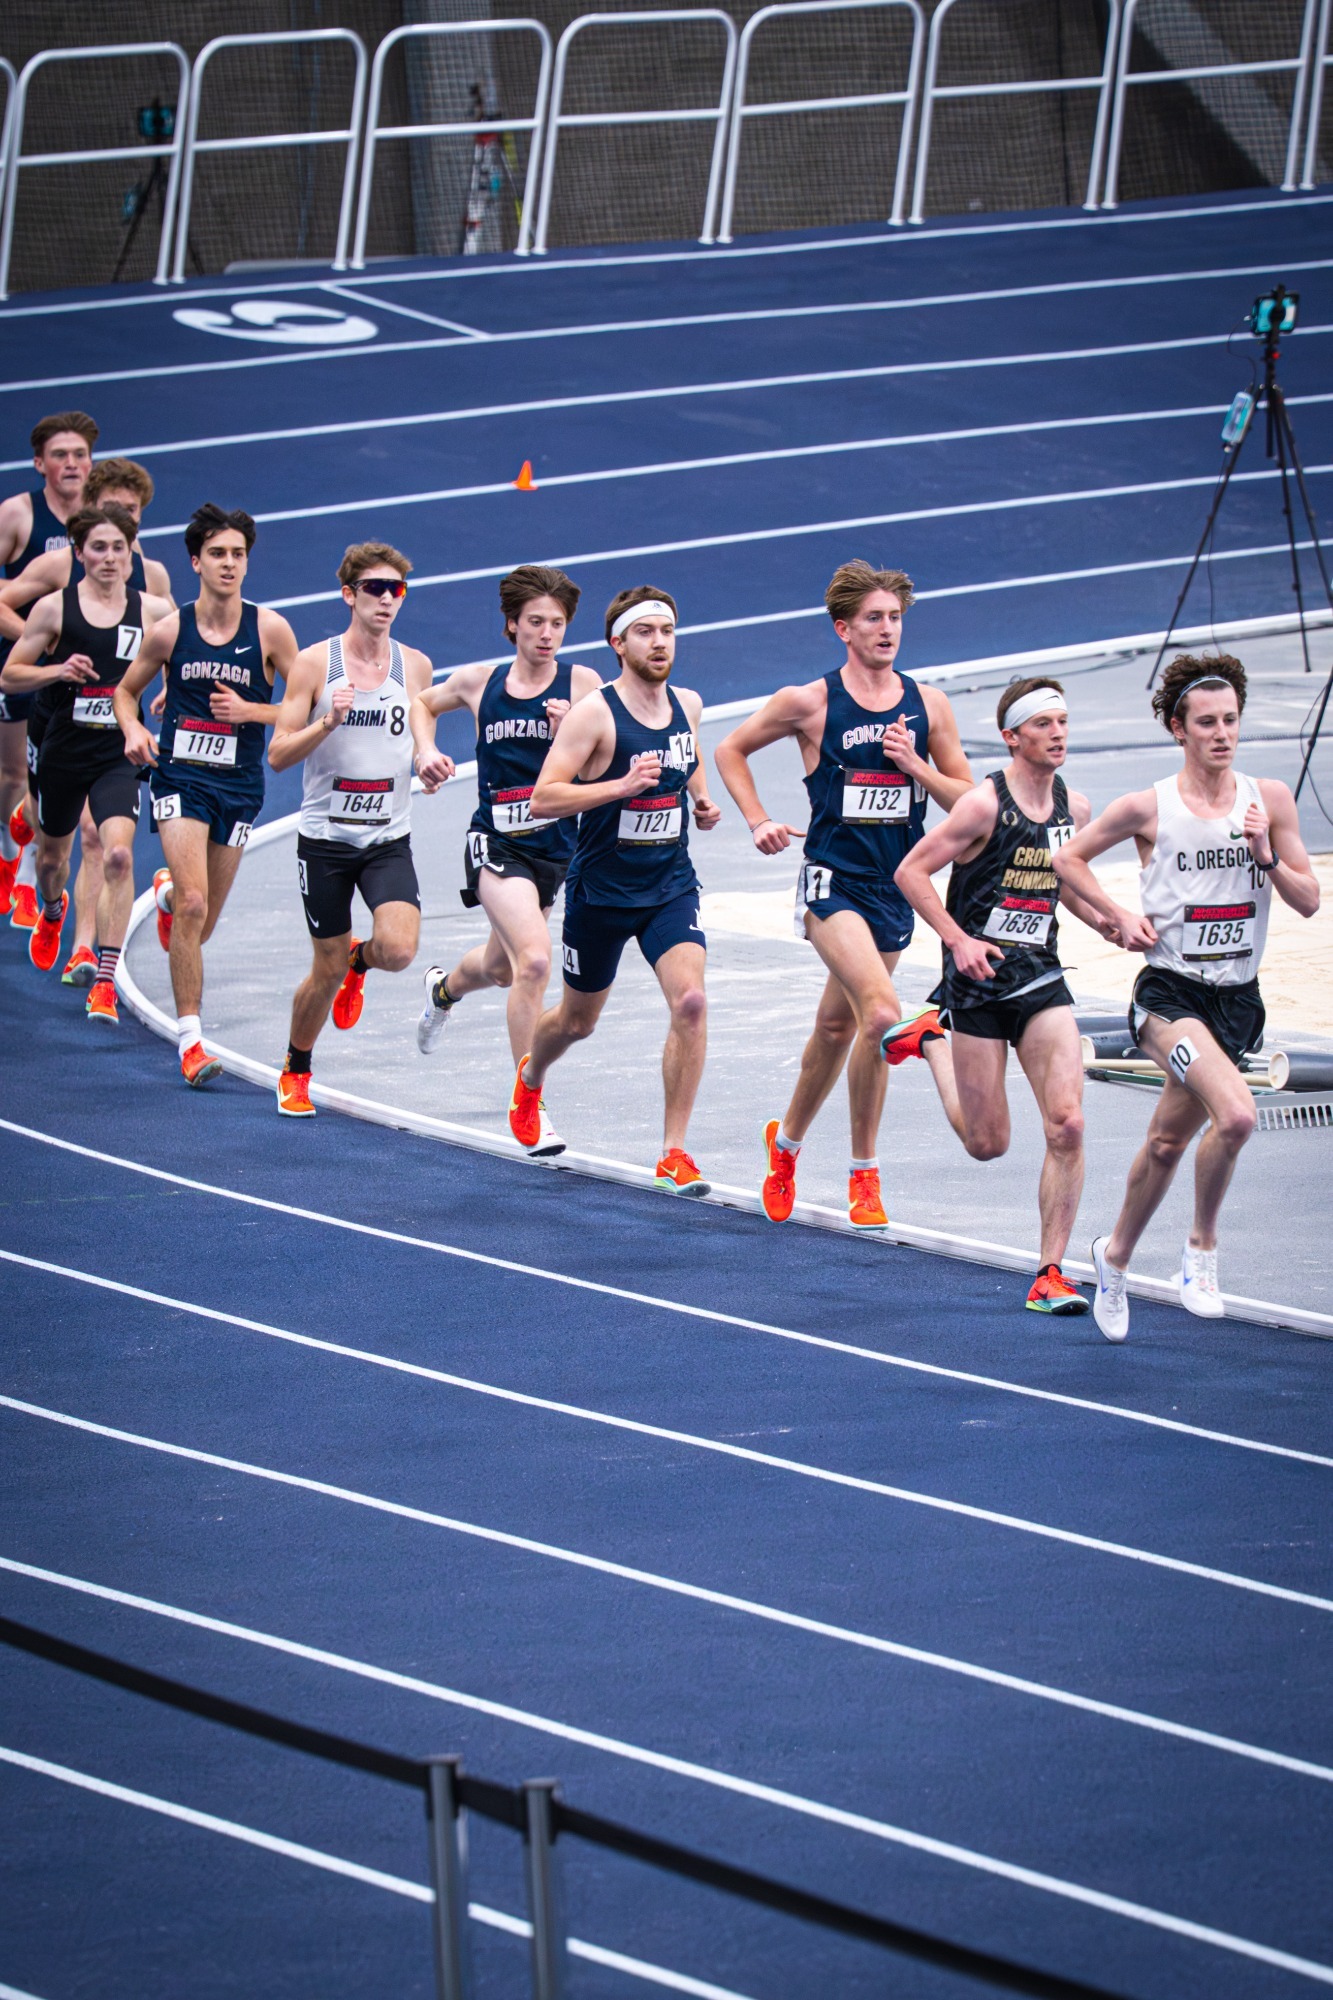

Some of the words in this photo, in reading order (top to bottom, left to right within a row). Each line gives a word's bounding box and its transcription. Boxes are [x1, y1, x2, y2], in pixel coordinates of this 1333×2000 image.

[123, 629, 137, 657] 7
[181, 661, 251, 687] GONZAGA
[85, 700, 112, 716] 163
[390, 705, 405, 736] 8
[187, 734, 226, 756] 1119
[675, 736, 692, 762] 14
[155, 796, 175, 819] 15
[342, 794, 384, 813] 1644
[858, 788, 901, 810] 1132
[507, 803, 540, 824] 112
[634, 811, 671, 833] 1121
[237, 824, 250, 846] 15
[1013, 847, 1054, 867] CROW
[1177, 851, 1191, 871] C.
[1197, 846, 1254, 870] OREGON
[298, 861, 306, 891] 8
[813, 870, 823, 900] 1
[1001, 868, 1058, 890] RUNNING
[1247, 863, 1266, 890] 10
[998, 912, 1043, 935] 1636
[1197, 921, 1245, 946] 1635
[562, 945, 575, 971] 14
[1171, 1044, 1191, 1074] 10
